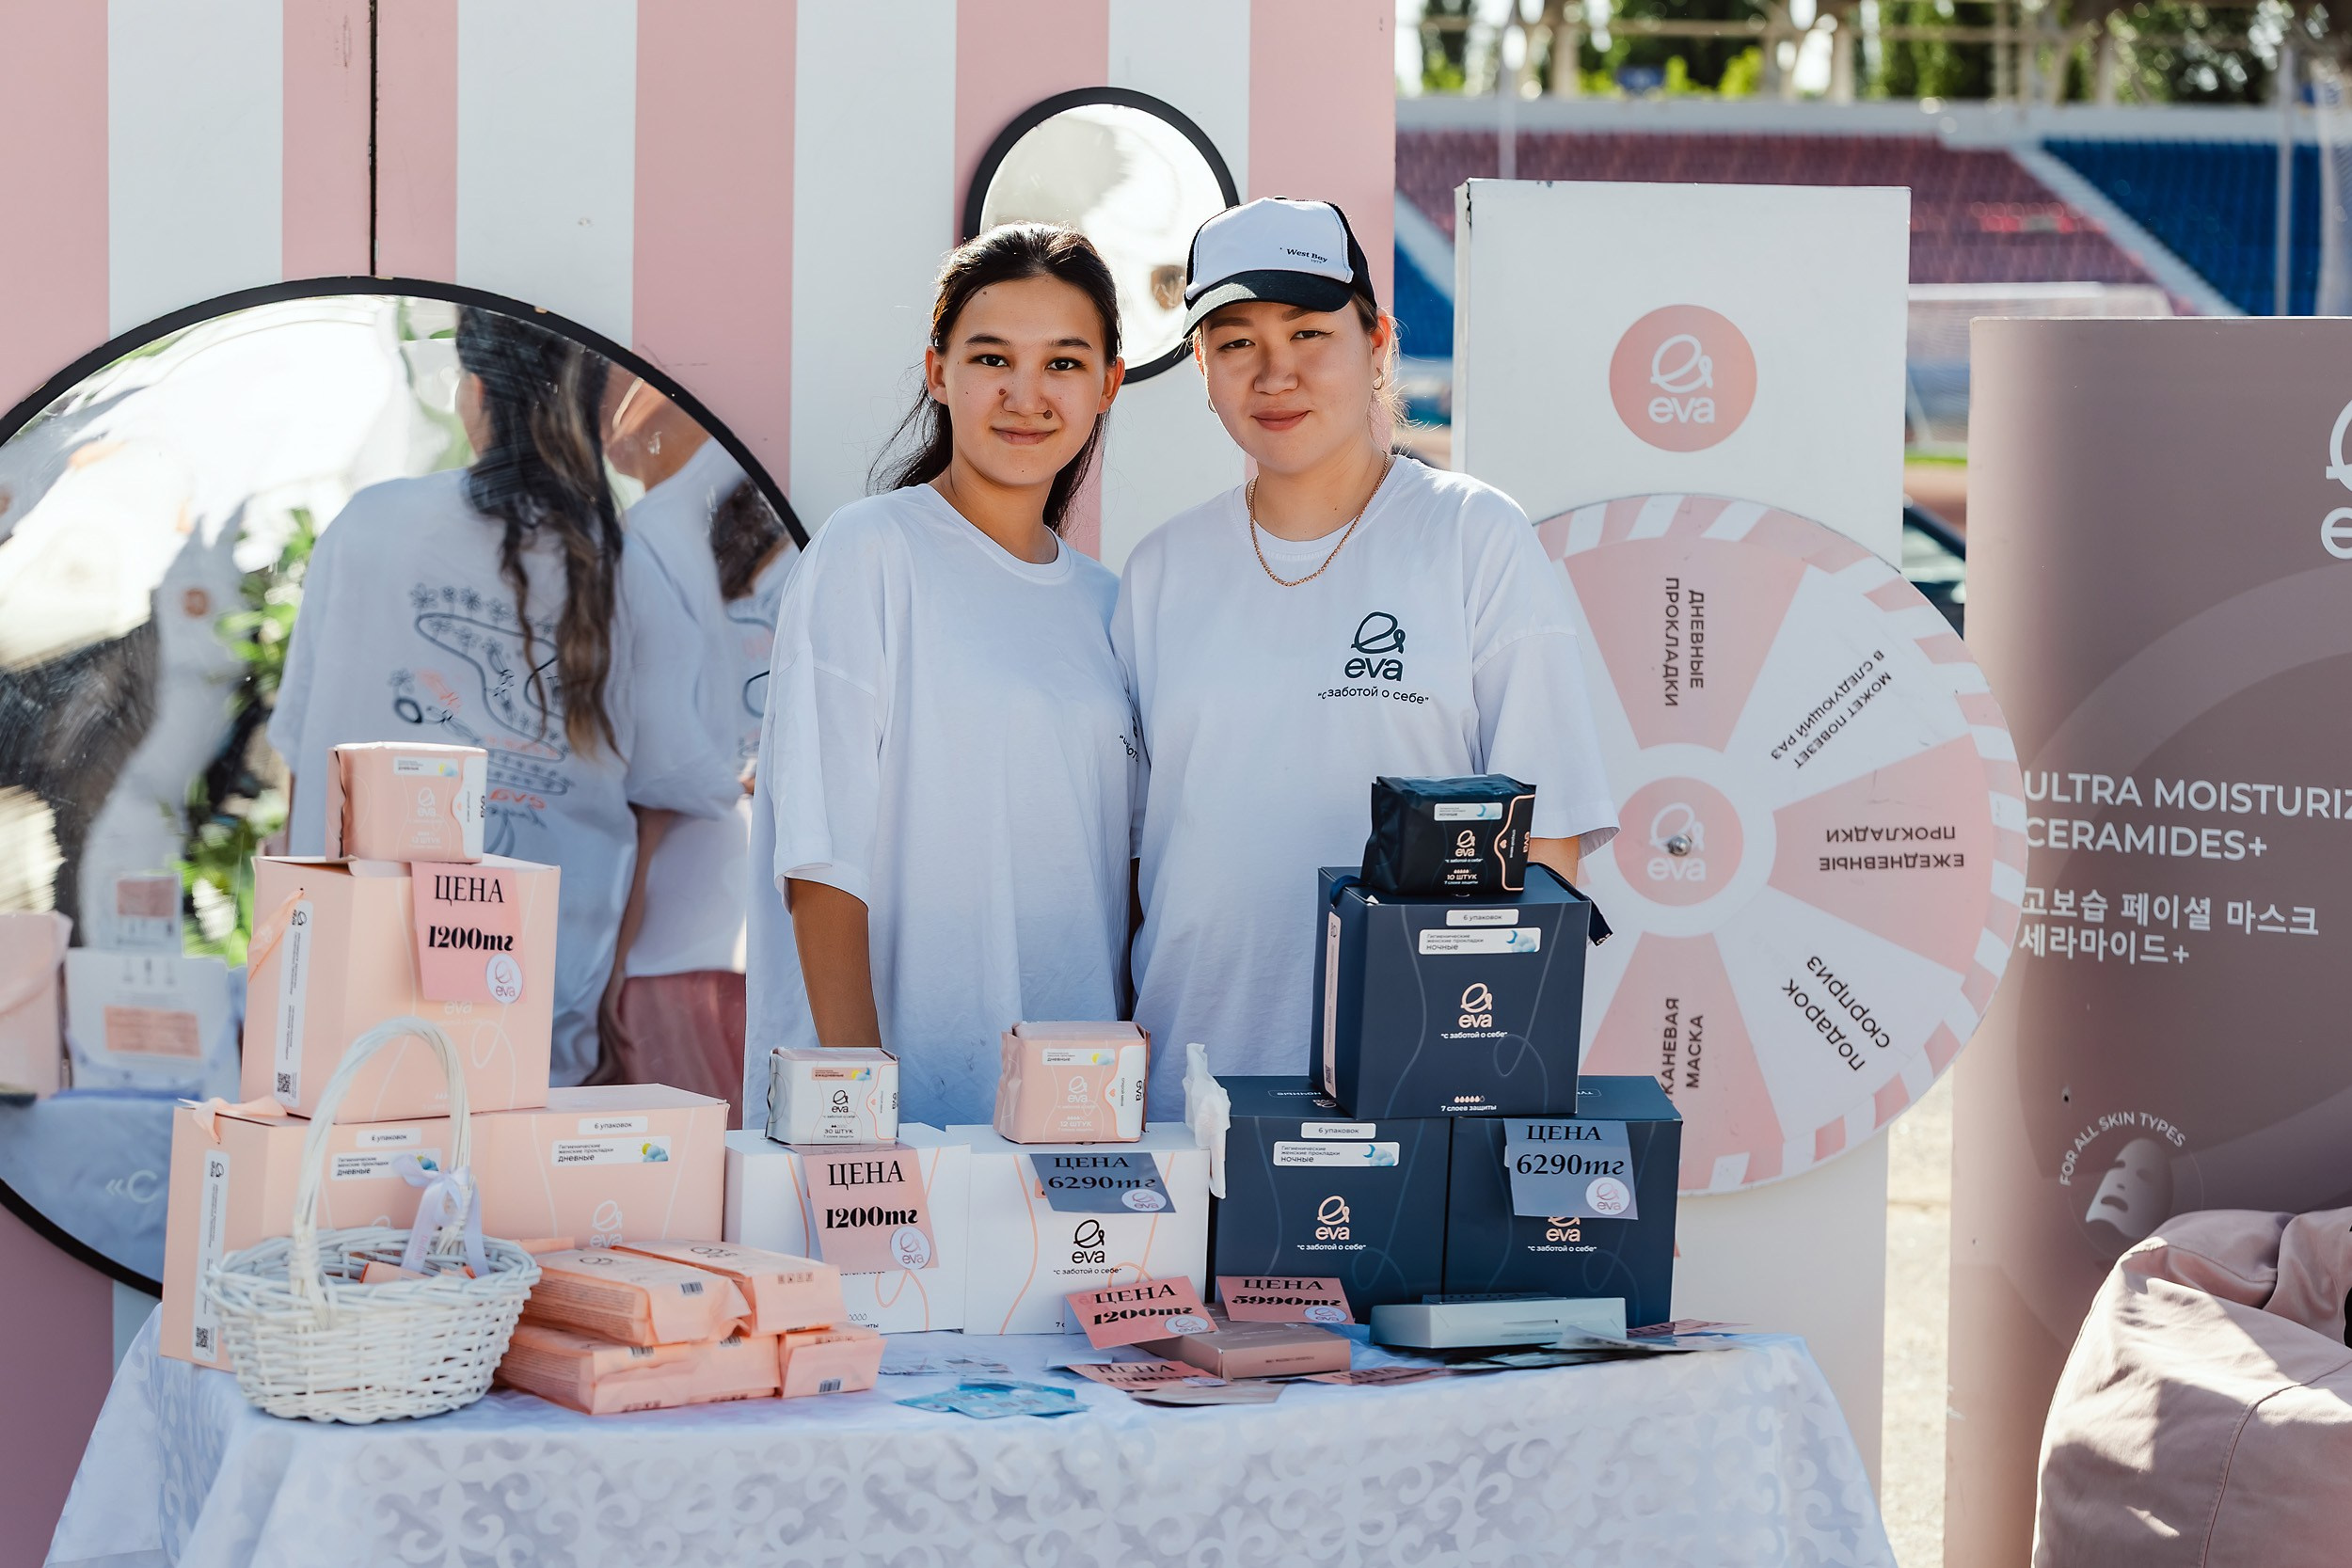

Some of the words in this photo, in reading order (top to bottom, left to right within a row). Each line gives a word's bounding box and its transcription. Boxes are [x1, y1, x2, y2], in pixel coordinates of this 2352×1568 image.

[1311, 253, 1327, 262] Bay
[1648, 396, 1715, 423] eva
[1663, 578, 1678, 706] ПРОКЛАДКИ
[1689, 590, 1704, 689] ДНЕВНЫЕ
[1344, 657, 1403, 681] eva
[1327, 687, 1377, 697] заботой
[1381, 689, 1390, 698] о
[1795, 660, 1873, 737] СЛЕДУЮЩИЙ
[1847, 672, 1892, 718] МОЖЕТ
[1771, 735, 1797, 760] РАЗ
[1794, 715, 1847, 769] ПОВЕЗЕТ
[2025, 770, 2142, 807] ULTRA
[1826, 826, 1955, 843] ПРОКЛАДКИ
[2026, 817, 2267, 861] CERAMIDES+
[1455, 847, 1475, 857] eva
[1820, 852, 1964, 871] ЕЖЕДНЕВНЫЕ
[1647, 858, 1707, 881] eva
[435, 875, 504, 906] ЦЕНА
[2022, 887, 2108, 923] 고보습
[2121, 893, 2211, 931] 페이셜
[2227, 900, 2319, 936] 마스크
[2019, 924, 2190, 965] 세라마이드+
[496, 986, 516, 997] eva
[1807, 957, 1889, 1048] сюрприз
[1458, 1014, 1492, 1028] eva
[1782, 978, 1865, 1070] подарок
[1661, 998, 1679, 1101] КАНЕВАЯ
[1686, 1015, 1704, 1088] МАСКА
[1068, 1095, 1089, 1103] eva
[1526, 1125, 1602, 1143] ЦЕНА
[2059, 1150, 2078, 1186] FOR
[2074, 1125, 2099, 1153] ALL
[2098, 1111, 2135, 1132] SKIN
[2139, 1112, 2186, 1148] TYPES
[827, 1160, 905, 1190] ЦЕНА
[1054, 1157, 1131, 1170] ЦЕНА
[1597, 1201, 1622, 1211] eva
[590, 1233, 623, 1248] eva
[1315, 1227, 1350, 1240] eva
[1546, 1228, 1581, 1242] eva
[902, 1254, 924, 1264] eva
[1072, 1250, 1105, 1263] eva
[1094, 1284, 1177, 1305] ЦЕНА
[1242, 1279, 1325, 1291] ЦЕНА
